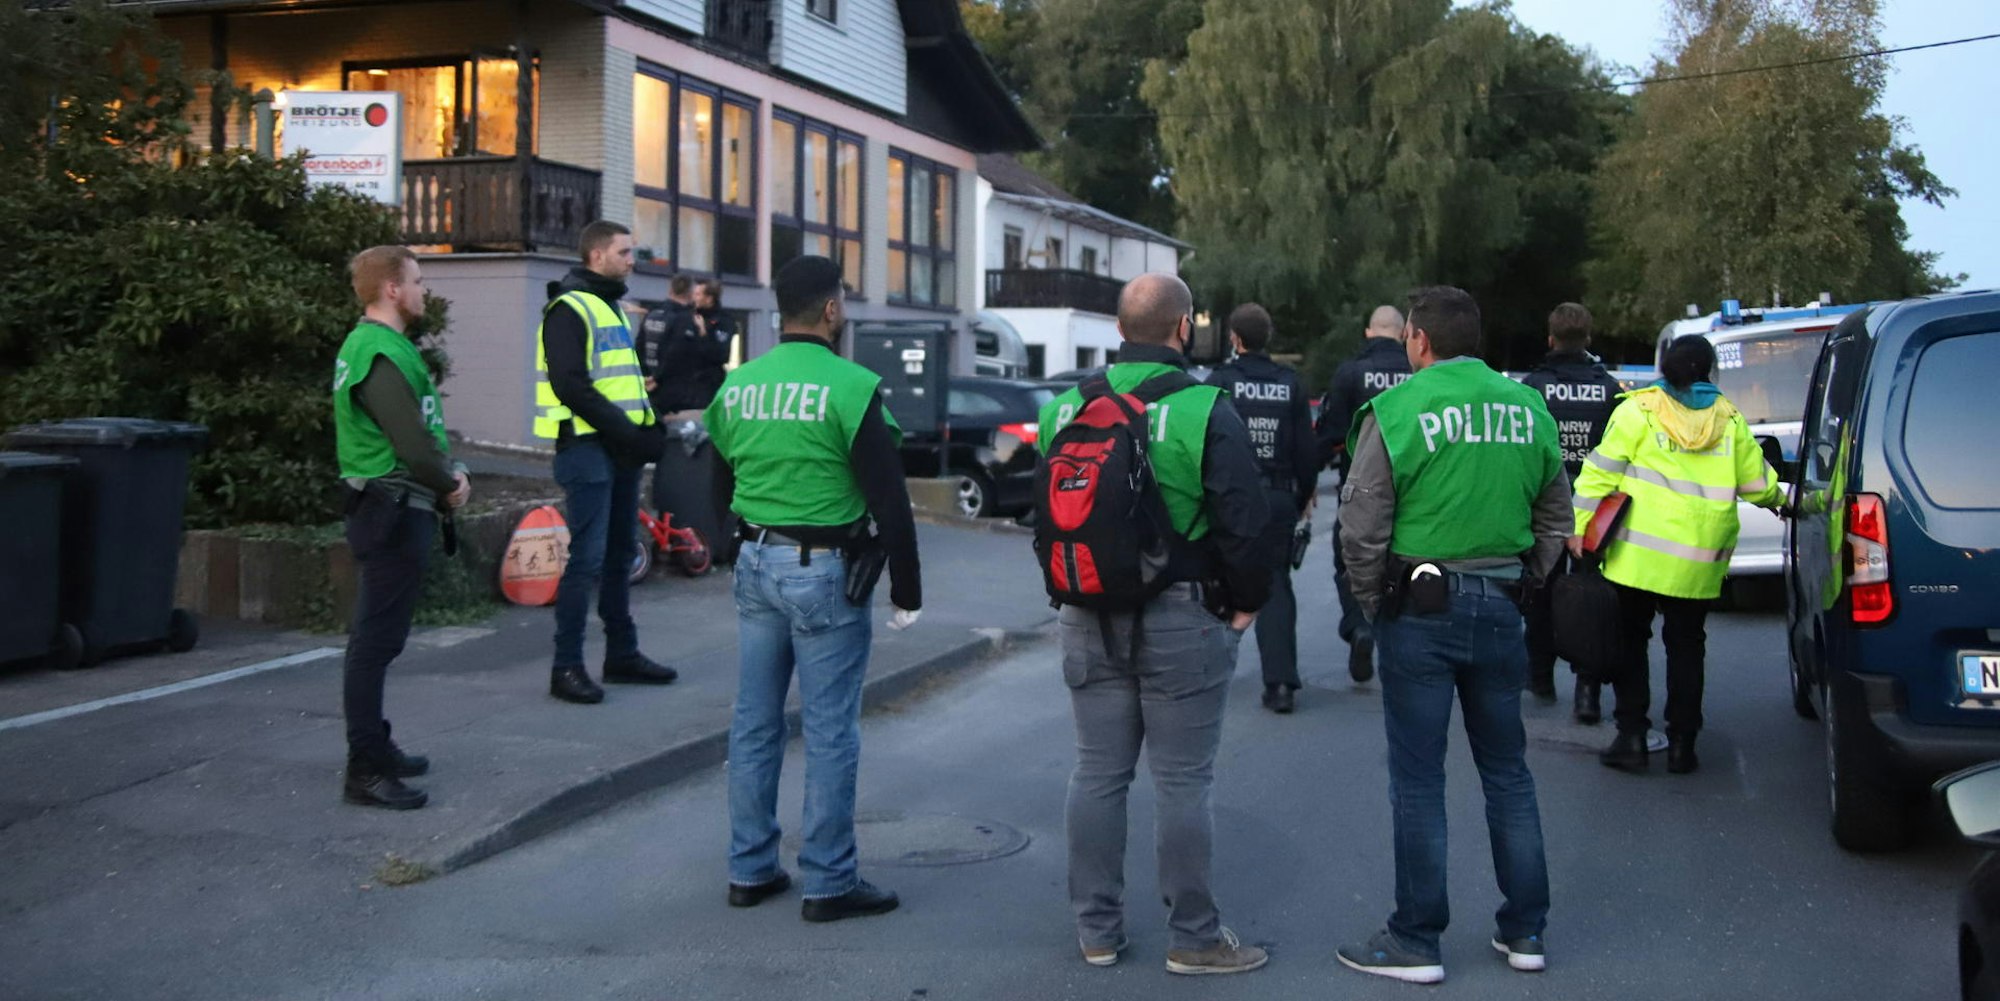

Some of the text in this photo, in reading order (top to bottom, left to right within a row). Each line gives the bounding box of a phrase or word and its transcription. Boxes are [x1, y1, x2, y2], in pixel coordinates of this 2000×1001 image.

[291, 105, 360, 116] BRÖTJE
[291, 119, 361, 127] HEIZUNG
[1716, 342, 1740, 353] NRW
[1718, 351, 1740, 361] 3131
[1234, 382, 1291, 401] POLIZEI
[1545, 383, 1606, 402] POLIZEI
[724, 382, 829, 422] POLIZEI
[1248, 417, 1279, 430] NRW
[1418, 402, 1534, 453] POLIZEI
[1559, 421, 1592, 433] NRW
[1249, 430, 1274, 443] 3131
[1560, 433, 1589, 446] 3131
[1909, 585, 1959, 593] COMBO
[1968, 677, 1977, 686] D
